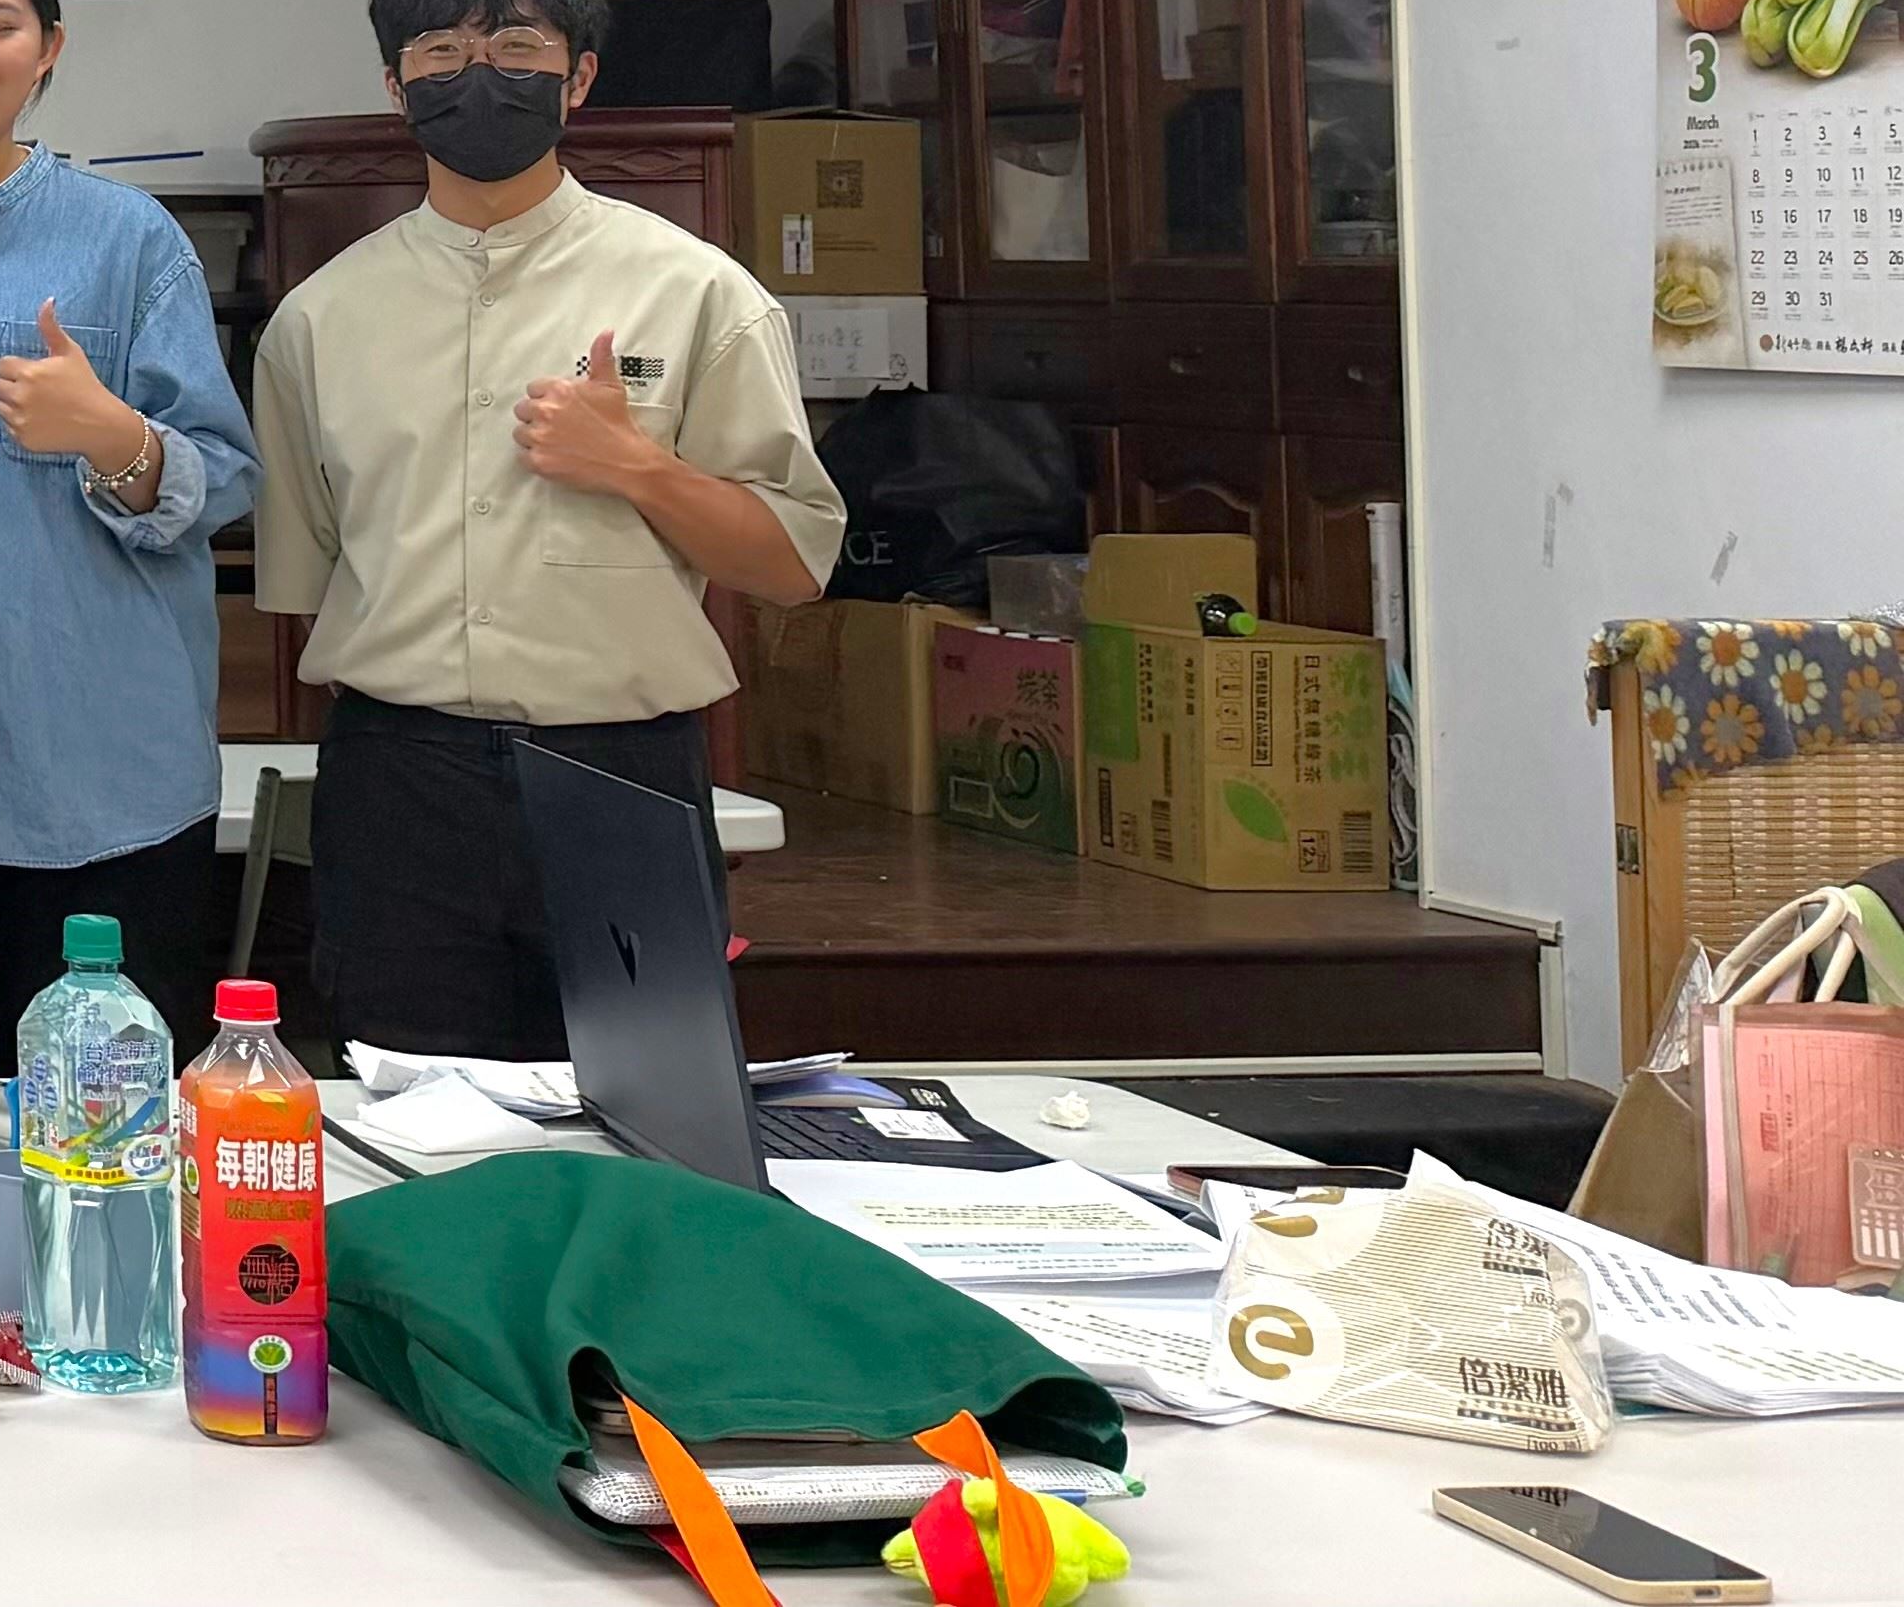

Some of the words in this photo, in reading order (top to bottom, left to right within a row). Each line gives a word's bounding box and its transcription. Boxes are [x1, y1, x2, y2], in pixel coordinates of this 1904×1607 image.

[1688, 37, 1717, 103] 3
[1686, 114, 1720, 130] March
[1753, 129, 1758, 143] 1
[1784, 127, 1793, 142] 2
[1818, 126, 1827, 141] 3
[1853, 125, 1862, 139] 4
[1889, 123, 1897, 138] 5
[1752, 168, 1760, 183] 8
[1784, 168, 1793, 183] 9
[1816, 167, 1831, 182] 10
[1851, 167, 1864, 181] 11
[1887, 165, 1902, 180] 12
[1751, 210, 1764, 224] 15
[1783, 209, 1798, 224] 16
[1817, 209, 1832, 224] 17
[1853, 208, 1868, 223] 18
[1888, 208, 1903, 223] 19
[1751, 250, 1765, 265] 22
[1784, 250, 1798, 265] 23
[1818, 250, 1833, 265] 24
[1853, 250, 1869, 265] 25
[1889, 250, 1904, 265] 26
[1751, 291, 1766, 306] 29
[1785, 291, 1800, 306] 30
[1819, 292, 1832, 306] 31
[838, 530, 893, 565] CE
[215, 1135, 318, 1192] 每朝健康
[1458, 1355, 1569, 1409] 倍潔雅
